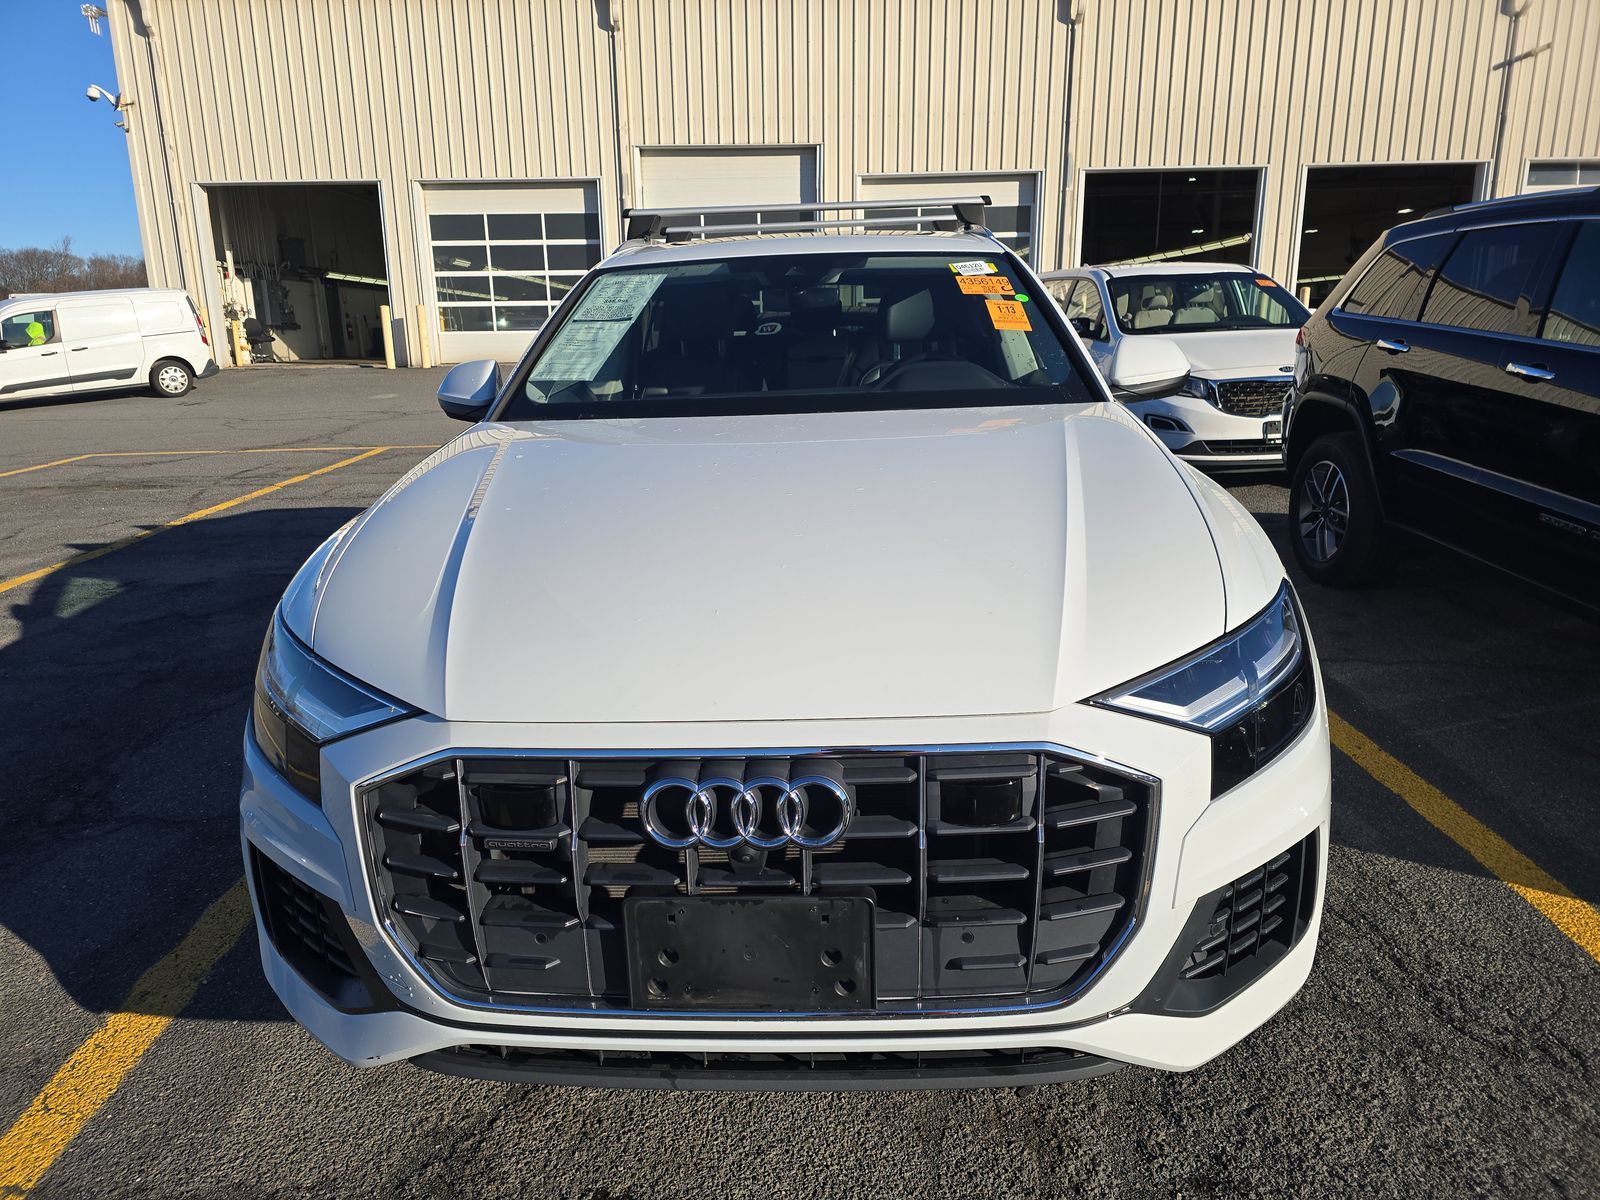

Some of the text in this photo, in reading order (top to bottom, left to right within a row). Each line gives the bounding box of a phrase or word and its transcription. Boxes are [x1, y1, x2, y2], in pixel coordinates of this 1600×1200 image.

[959, 277, 1010, 286] 4356149
[997, 305, 1016, 314] 1:13
[488, 841, 549, 849] quattro
